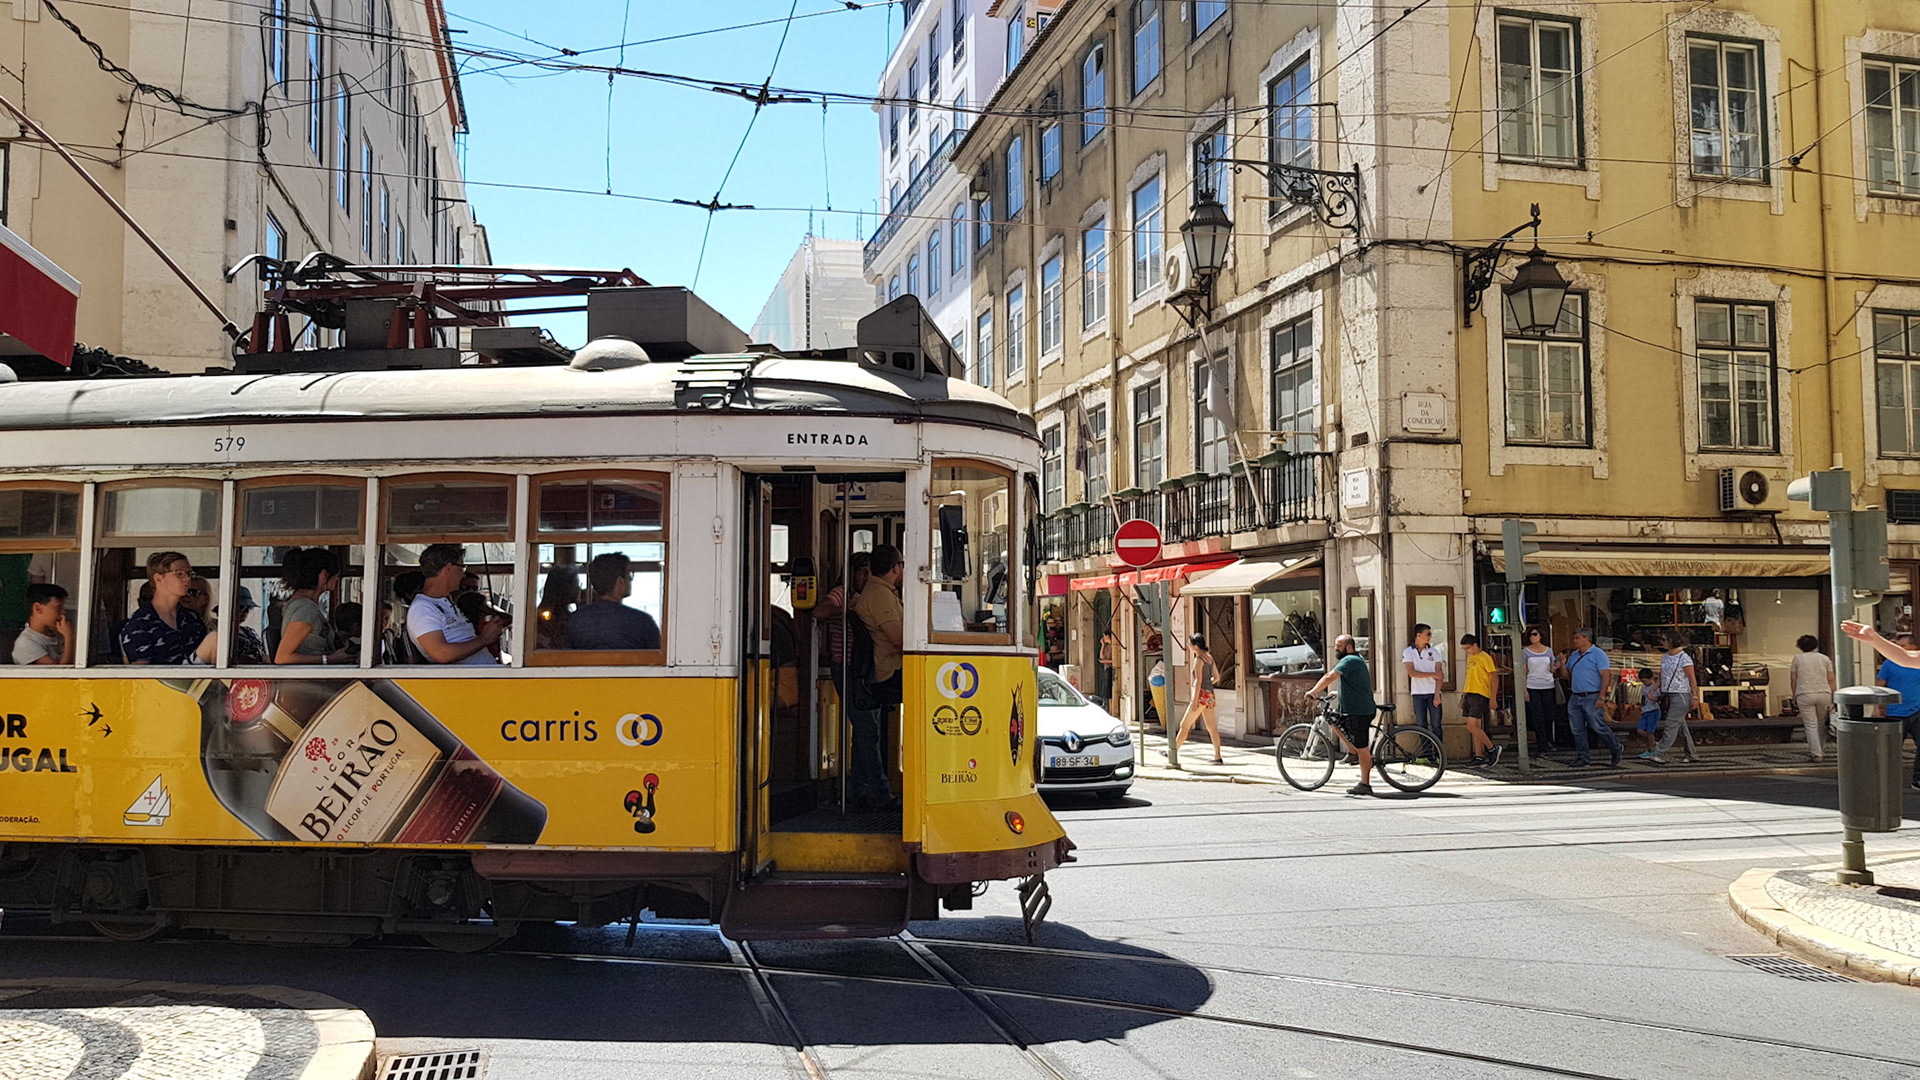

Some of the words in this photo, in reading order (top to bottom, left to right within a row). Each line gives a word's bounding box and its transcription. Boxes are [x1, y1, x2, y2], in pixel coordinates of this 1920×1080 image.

[1417, 400, 1432, 408] RUA
[214, 437, 246, 452] 579
[787, 433, 869, 445] ENTRADA
[500, 710, 599, 742] carris
[315, 738, 355, 792] LICOR
[299, 719, 398, 841] BEIRÃO
[941, 770, 978, 784] BEIRÃO
[341, 807, 363, 834] LICOR
[361, 793, 373, 807] DE
[371, 748, 406, 793] PORTUGAL
